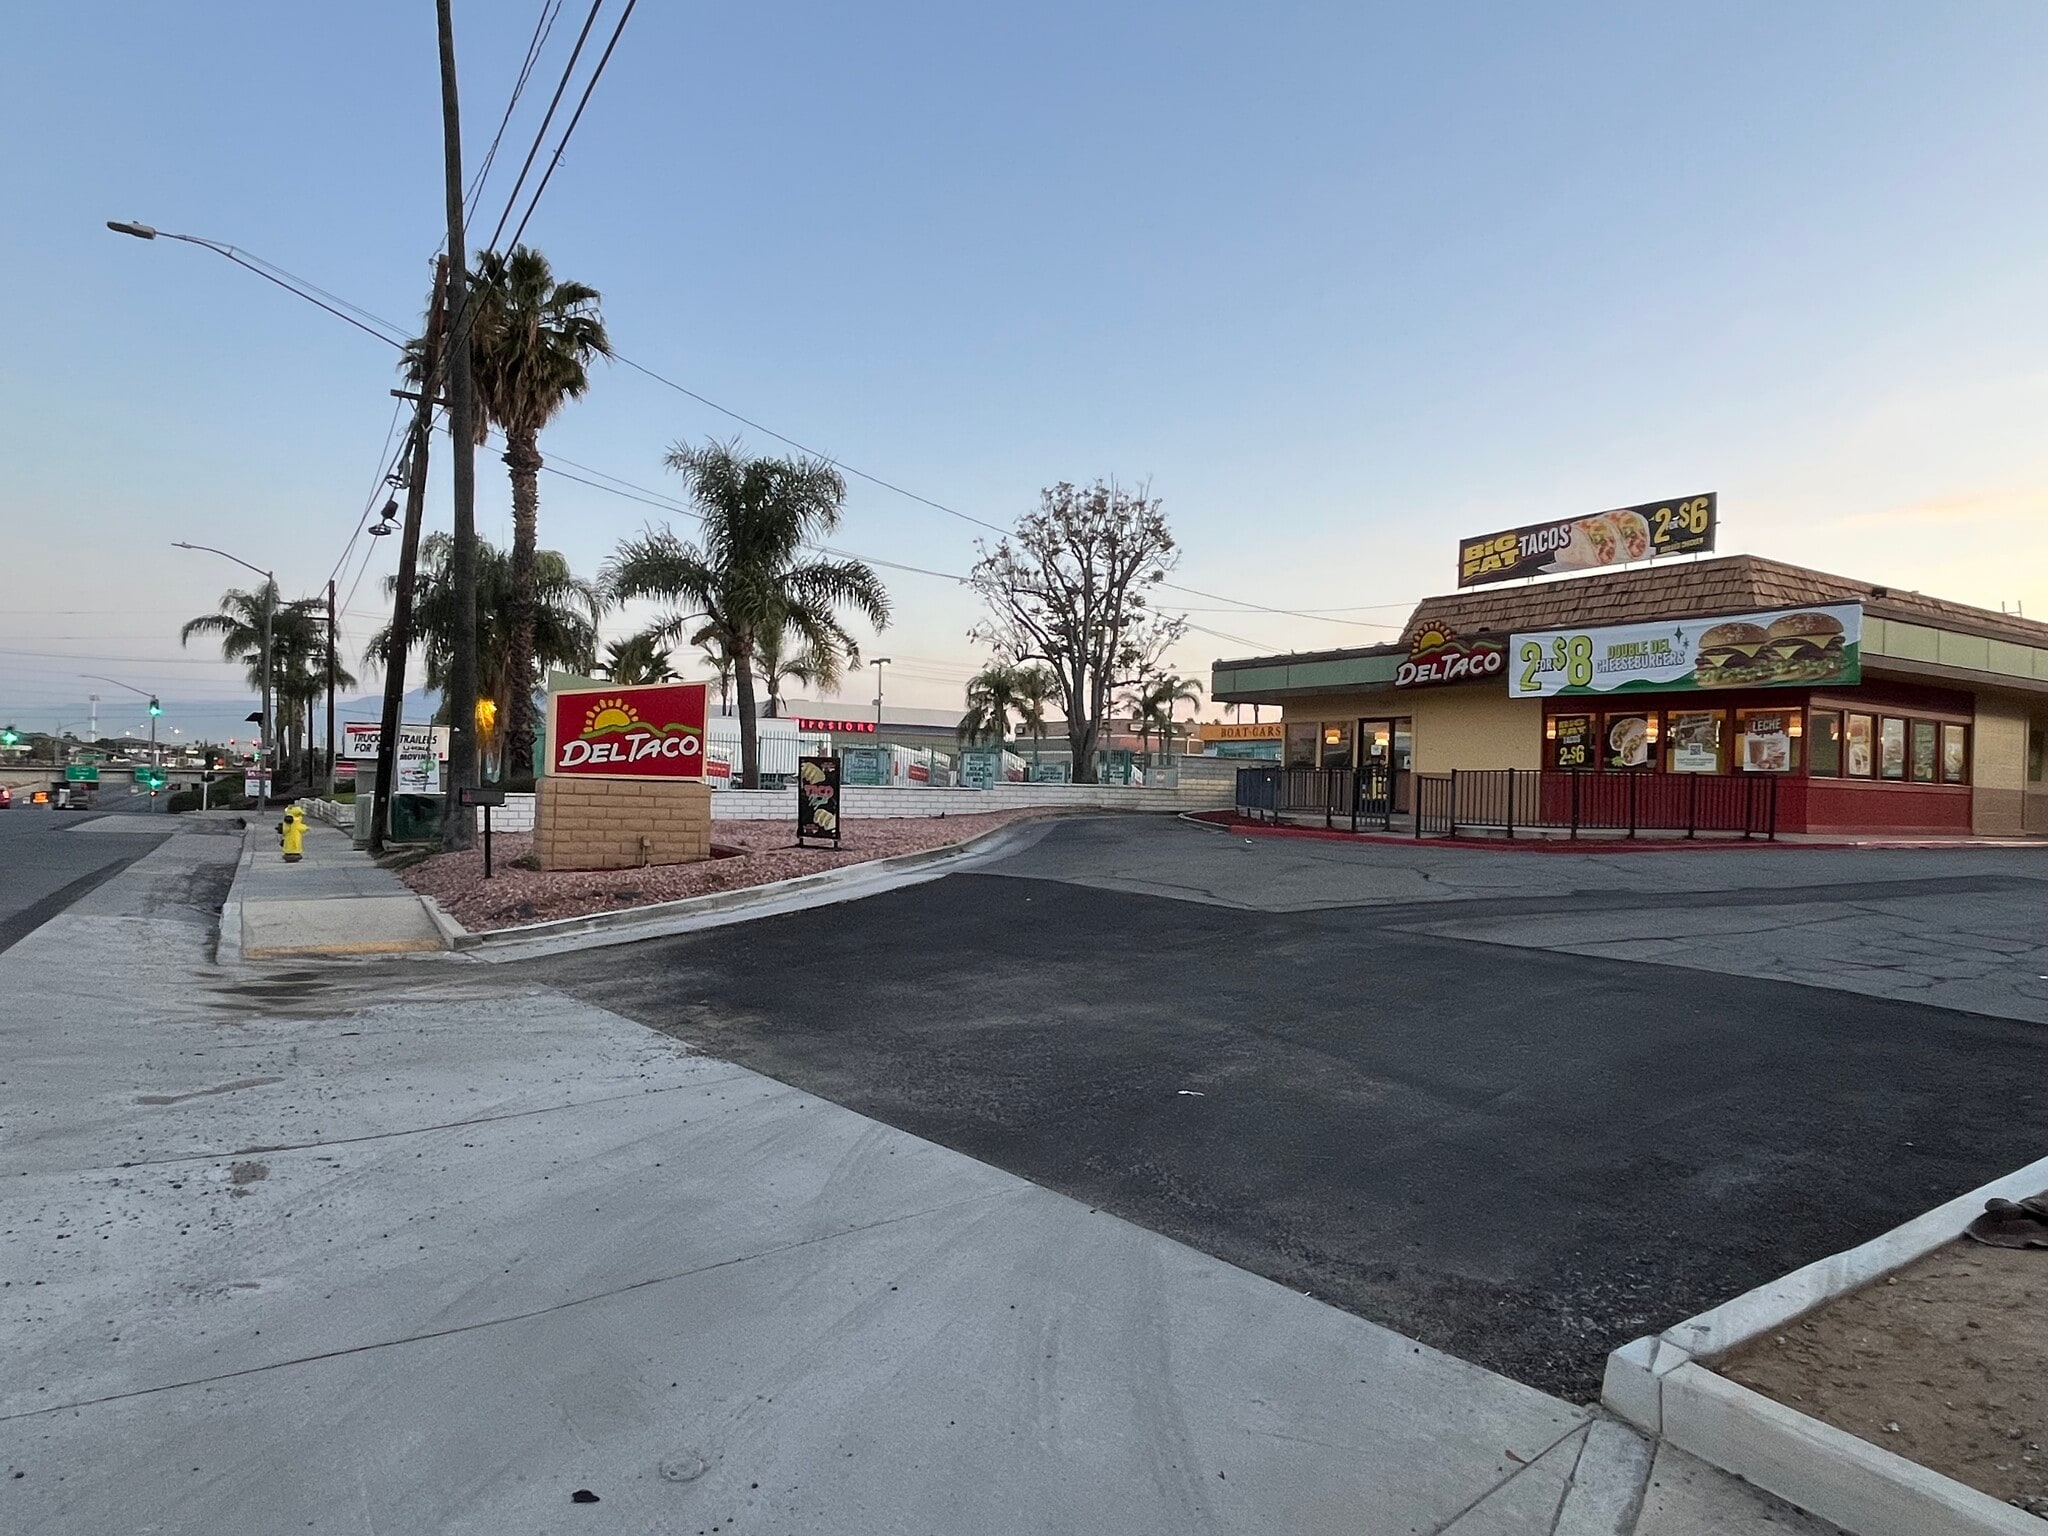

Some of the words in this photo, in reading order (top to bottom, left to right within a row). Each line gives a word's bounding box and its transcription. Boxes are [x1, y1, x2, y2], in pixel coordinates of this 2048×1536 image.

[1653, 507, 1672, 544] 2
[1679, 497, 1709, 534] $6
[1520, 524, 1570, 557] TACOS
[1463, 548, 1519, 577] FAT
[1607, 641, 1649, 660] DOUBLE
[1651, 638, 1672, 655] DEL
[1395, 662, 1443, 686] DEL
[1441, 652, 1501, 680] TACO
[1520, 642, 1542, 691] 2
[1535, 658, 1554, 672] FOR
[1552, 635, 1593, 687] $8
[1596, 650, 1686, 674] CHEESEBURGERS
[800, 719, 876, 733] irestone
[1220, 726, 1250, 738] BOAT
[1252, 726, 1281, 737] CARS
[1752, 718, 1781, 732] LECHE
[354, 743, 371, 753] FOR
[558, 739, 627, 767] DEL
[624, 733, 699, 763] TACO
[1559, 747, 1568, 765] 2
[803, 784, 835, 797] TACO
